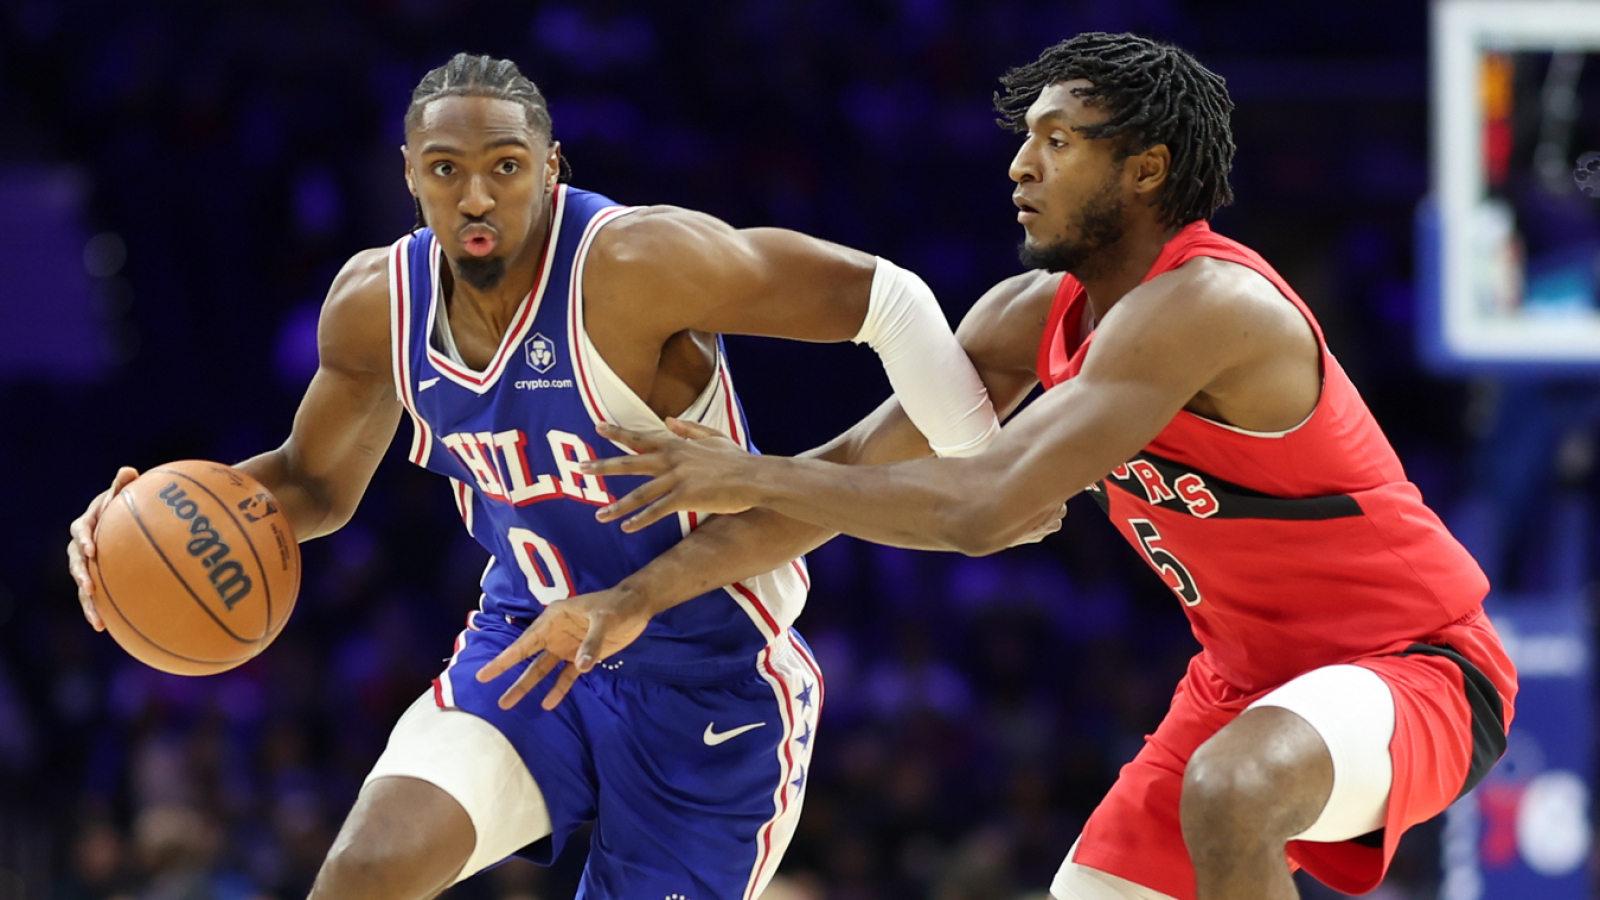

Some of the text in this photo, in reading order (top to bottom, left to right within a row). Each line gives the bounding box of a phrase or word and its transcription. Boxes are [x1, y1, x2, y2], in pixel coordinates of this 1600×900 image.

[514, 378, 573, 390] crypto.com
[441, 429, 616, 507] HILA
[157, 482, 252, 612] Wilson
[507, 527, 576, 607] 0
[1128, 518, 1202, 607] 5
